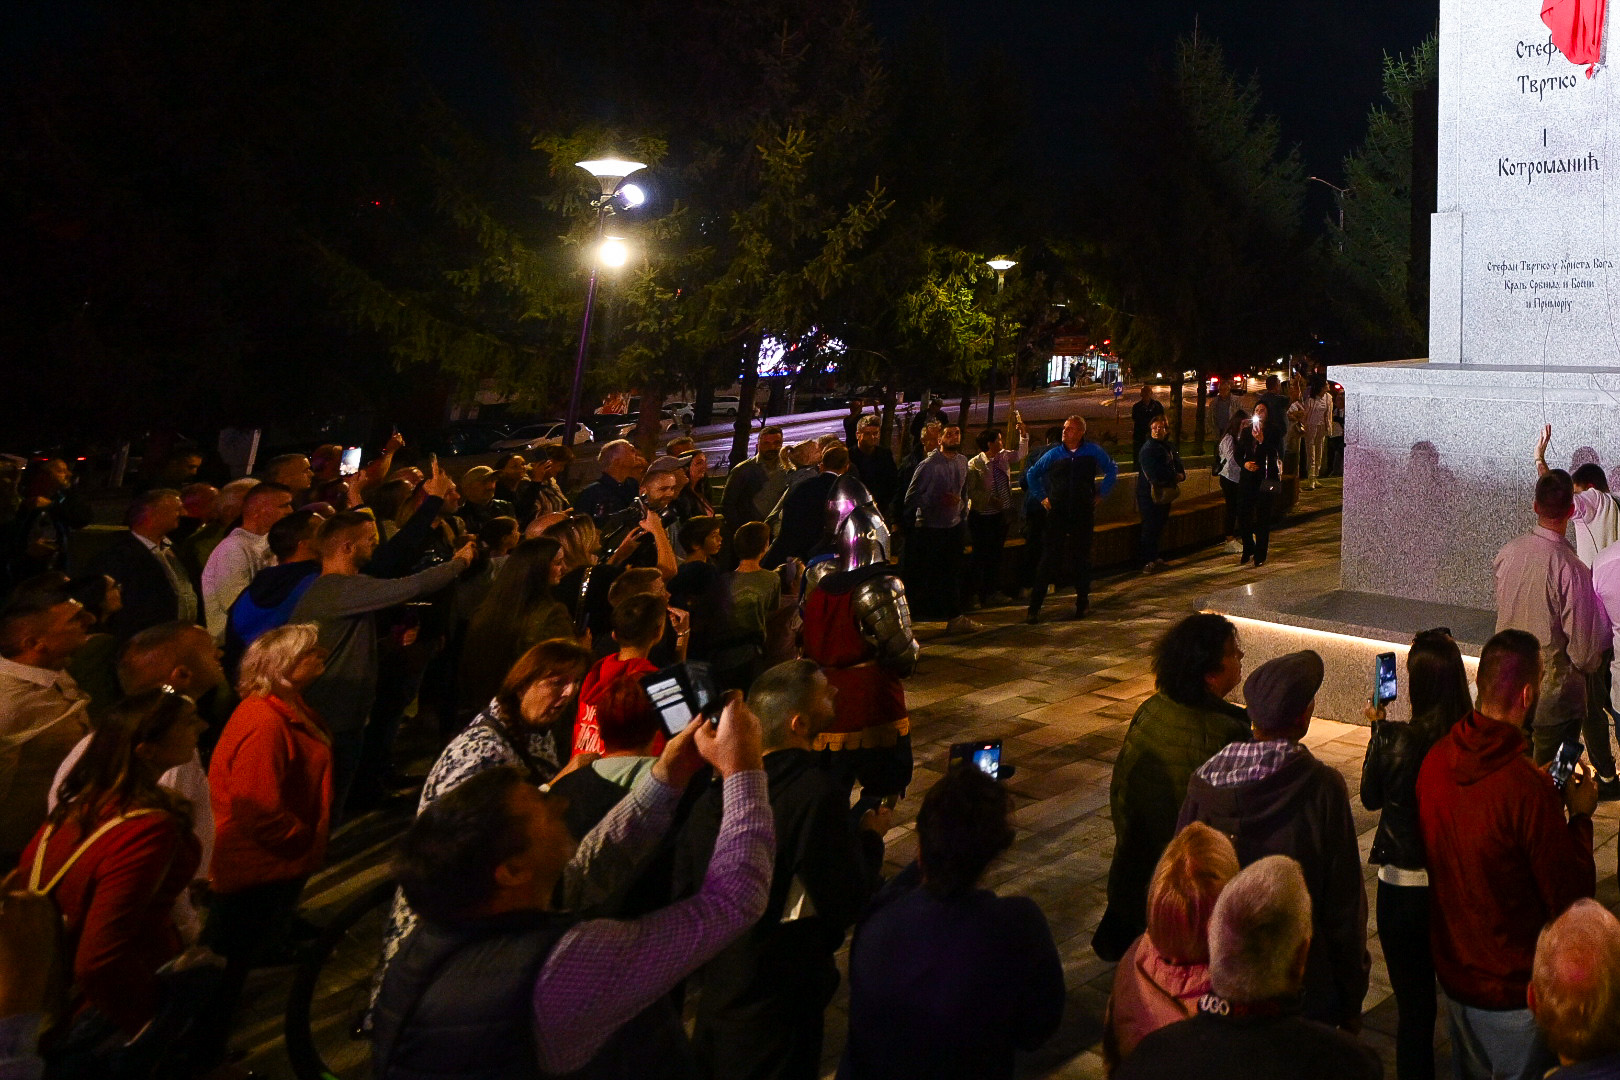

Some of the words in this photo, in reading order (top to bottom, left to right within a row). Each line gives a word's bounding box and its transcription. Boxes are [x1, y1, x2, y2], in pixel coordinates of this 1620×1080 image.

[1516, 33, 1562, 66] Стеф
[1517, 75, 1577, 102] Твртко
[1498, 151, 1600, 186] Котроманић
[1487, 260, 1518, 276] Стефан
[1520, 260, 1551, 275] Твртко
[1560, 260, 1591, 275] Христа
